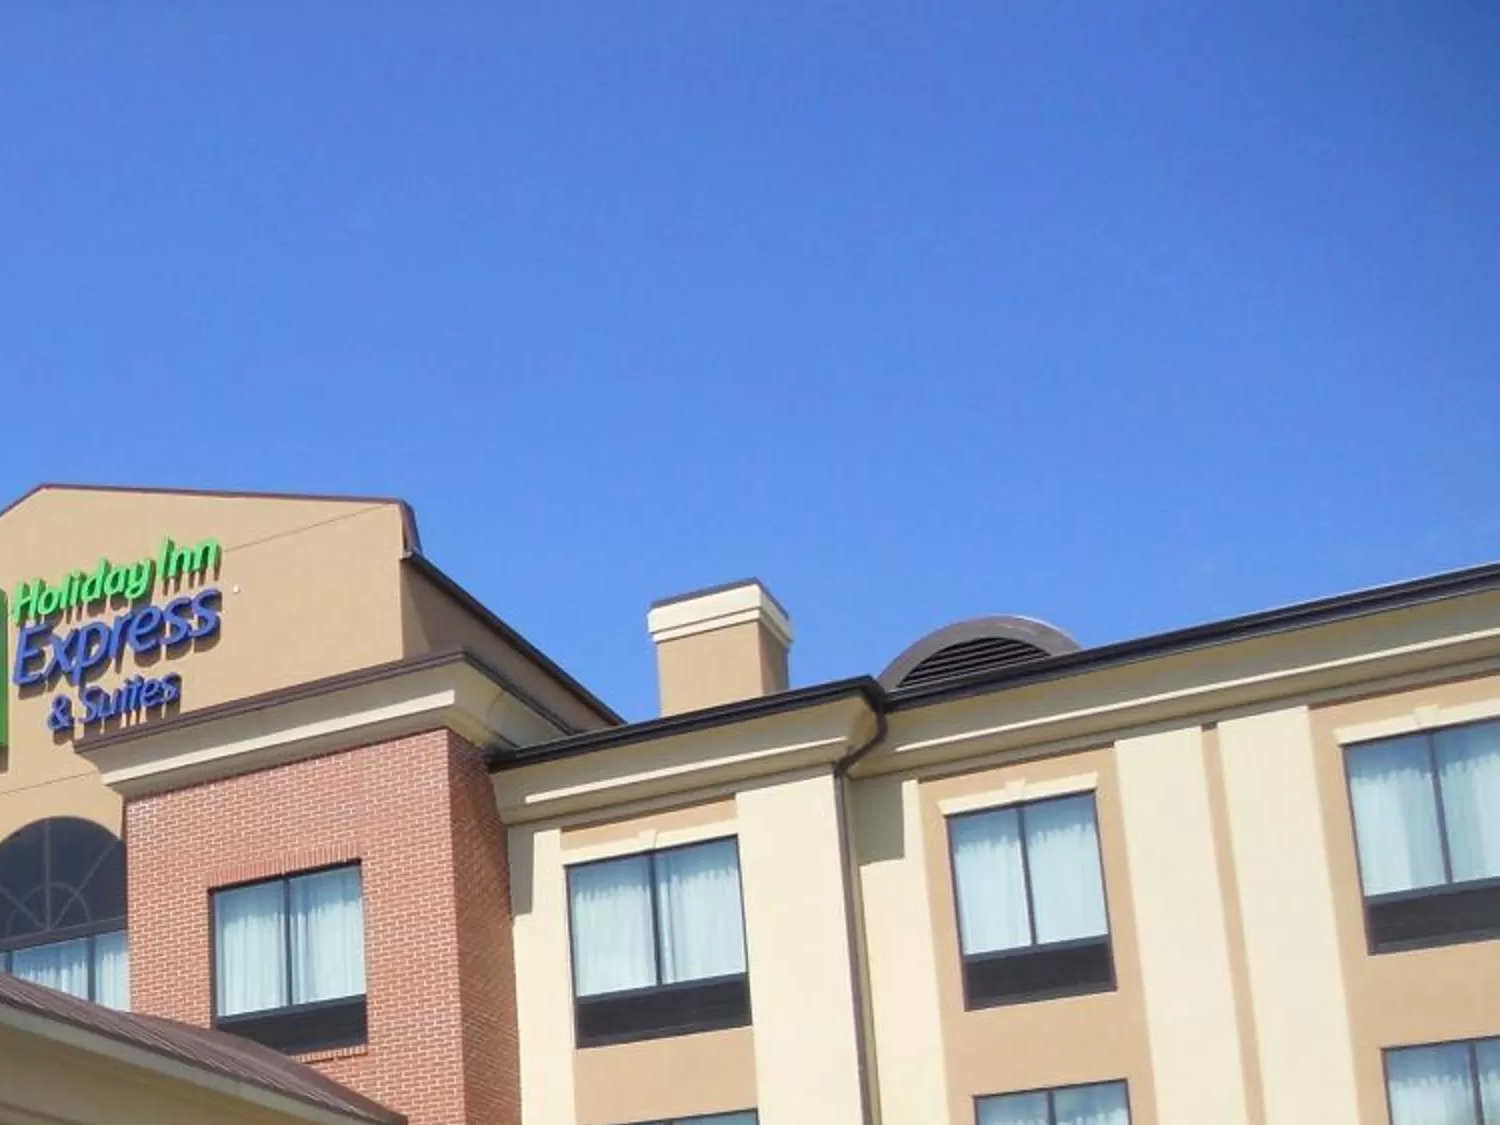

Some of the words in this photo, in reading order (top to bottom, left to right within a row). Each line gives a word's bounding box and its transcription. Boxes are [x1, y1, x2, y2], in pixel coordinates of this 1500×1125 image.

[12, 556, 156, 626] Holiday
[158, 536, 221, 581] Inn
[12, 588, 223, 688] Express
[48, 694, 75, 731] &
[78, 672, 182, 723] Suites
